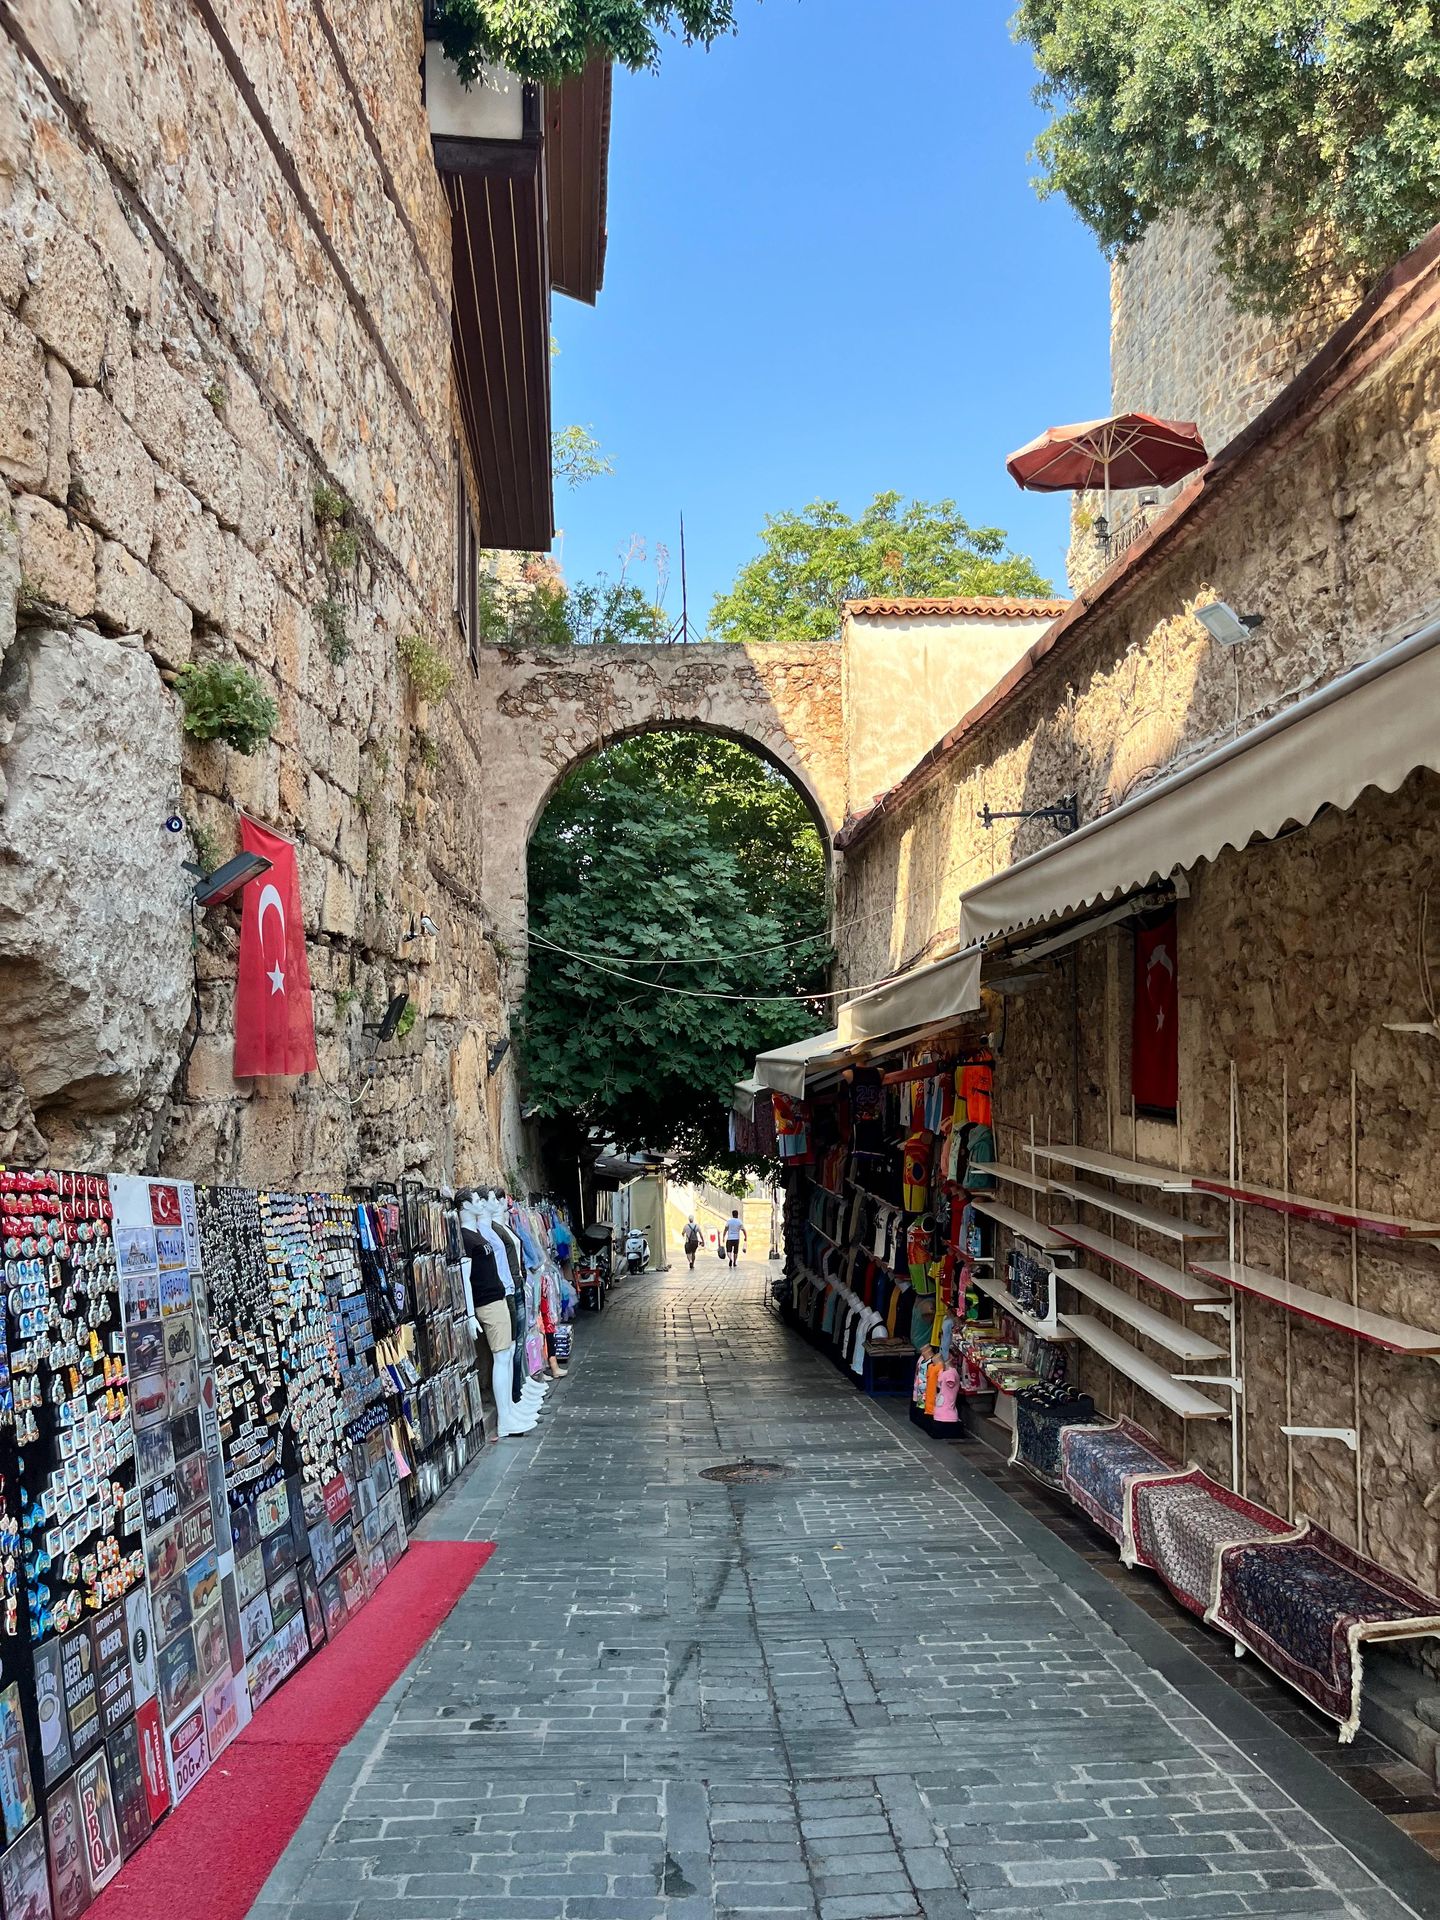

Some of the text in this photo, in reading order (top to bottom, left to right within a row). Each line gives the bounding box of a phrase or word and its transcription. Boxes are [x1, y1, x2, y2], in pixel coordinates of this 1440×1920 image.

[183, 1187, 194, 1219] 1928
[204, 1410, 219, 1456] BEER
[201, 1524, 213, 1545] OK
[95, 1605, 123, 1635] BRING ME
[65, 1635, 80, 1657] MAKE
[100, 1628, 124, 1660] BEER
[136, 1631, 145, 1661] MINI
[63, 1656, 83, 1689] BEER
[104, 1667, 128, 1698] TAKE ME
[66, 1673, 96, 1708] DISAPPEAR
[106, 1694, 132, 1727] FISHIN
[151, 1720, 165, 1792] CHEVROLET
[176, 1757, 195, 1792] DOG
[82, 1786, 105, 1873] BBQ
